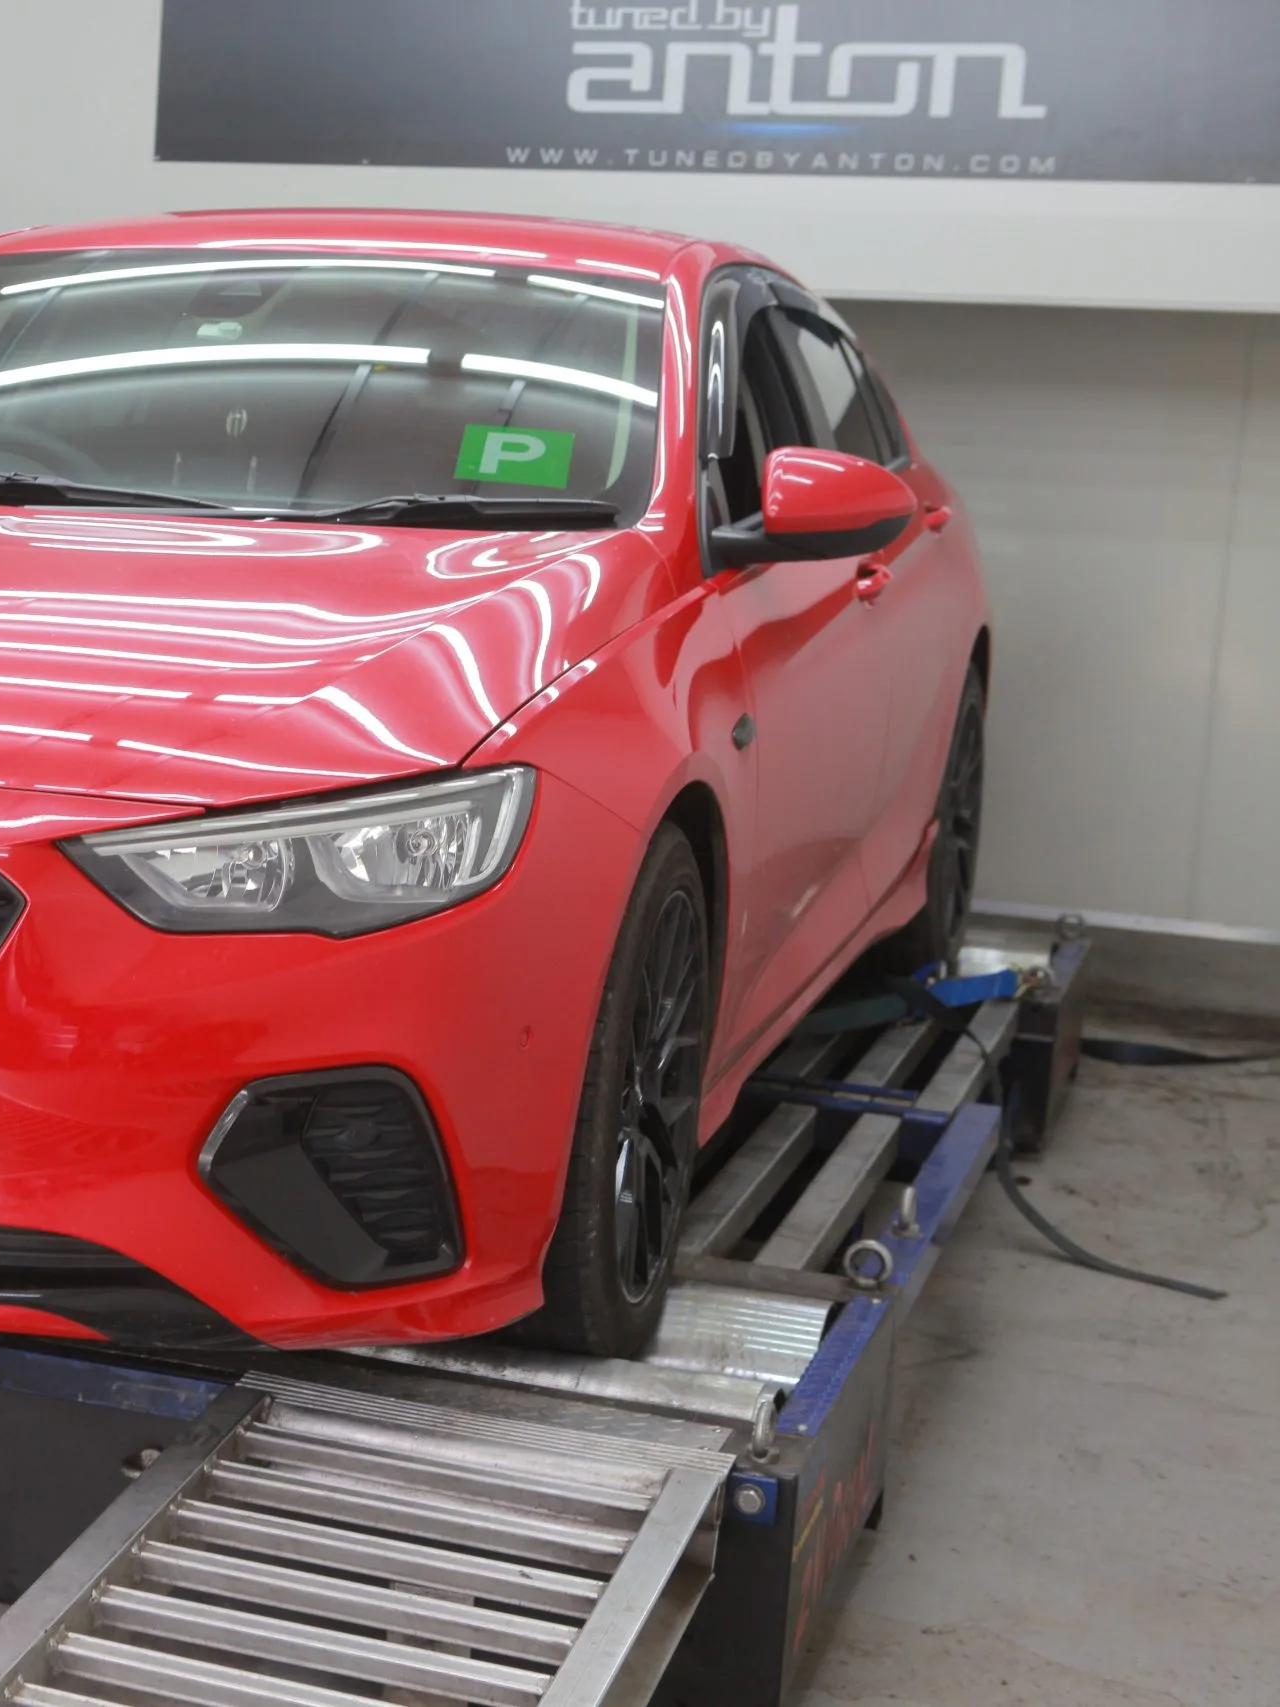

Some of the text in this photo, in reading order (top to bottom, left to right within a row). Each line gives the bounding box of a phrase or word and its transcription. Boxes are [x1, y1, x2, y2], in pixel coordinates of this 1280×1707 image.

[569, 0, 771, 38] tuned by
[566, 4, 1047, 119] anton
[504, 146, 1057, 175] WWW.TUNEDBYANTON.COM
[478, 431, 547, 475] P
